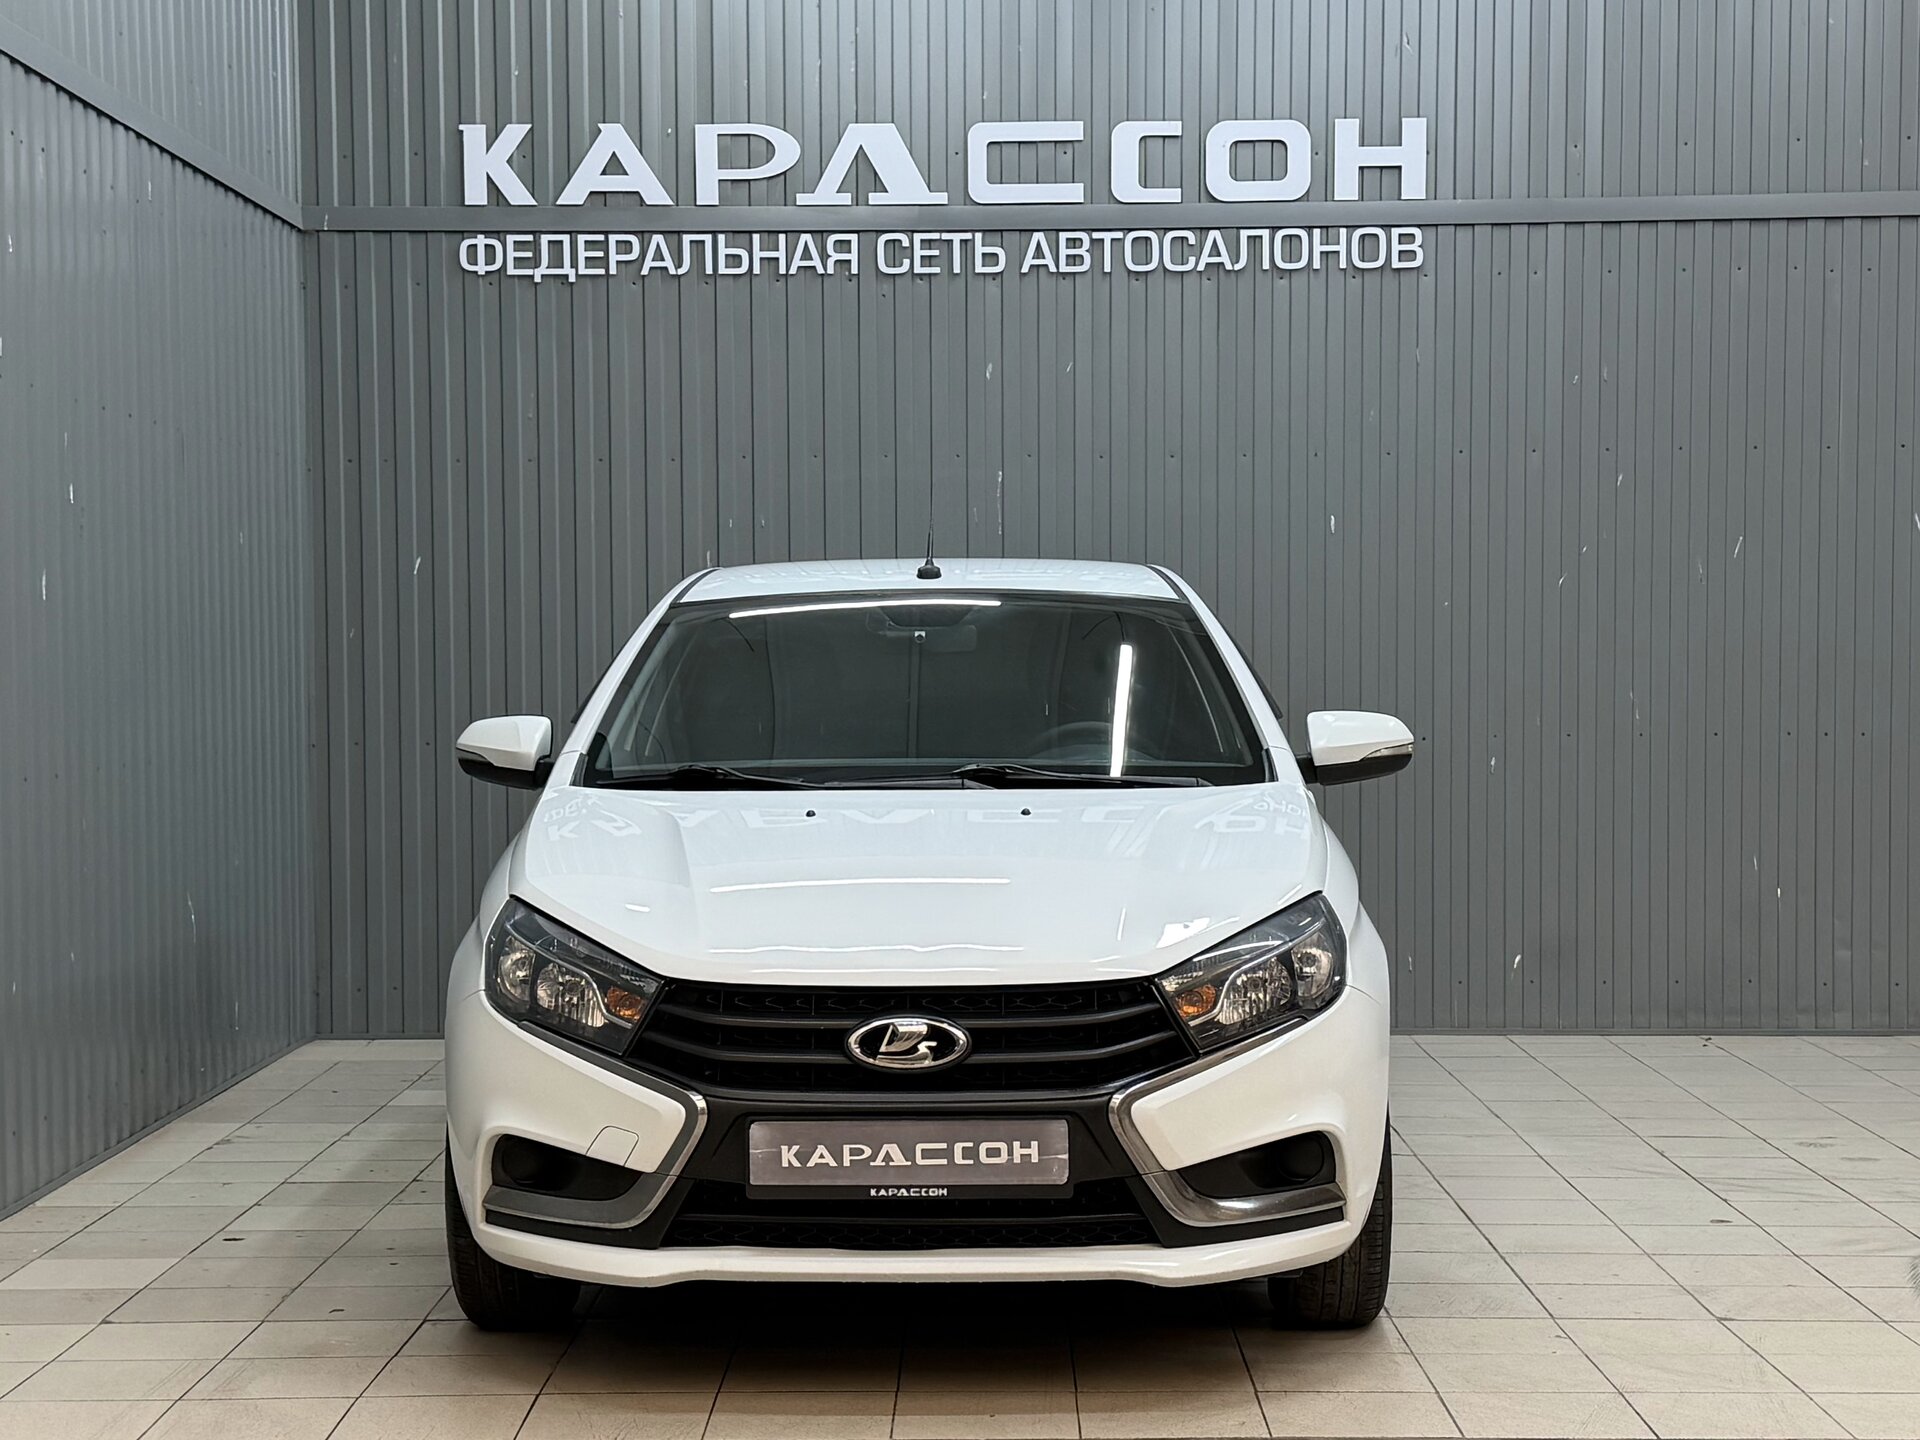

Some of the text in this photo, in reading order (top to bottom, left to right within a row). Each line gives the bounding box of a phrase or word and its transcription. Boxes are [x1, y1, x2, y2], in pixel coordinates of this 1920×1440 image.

[458, 117, 1428, 206] КАРАССОН
[458, 227, 1425, 283] ФЕДЕРАЛЬНАЯ СЕТЬ АВТОСАЛОНОВ
[779, 1140, 1040, 1169] КАРАССОН
